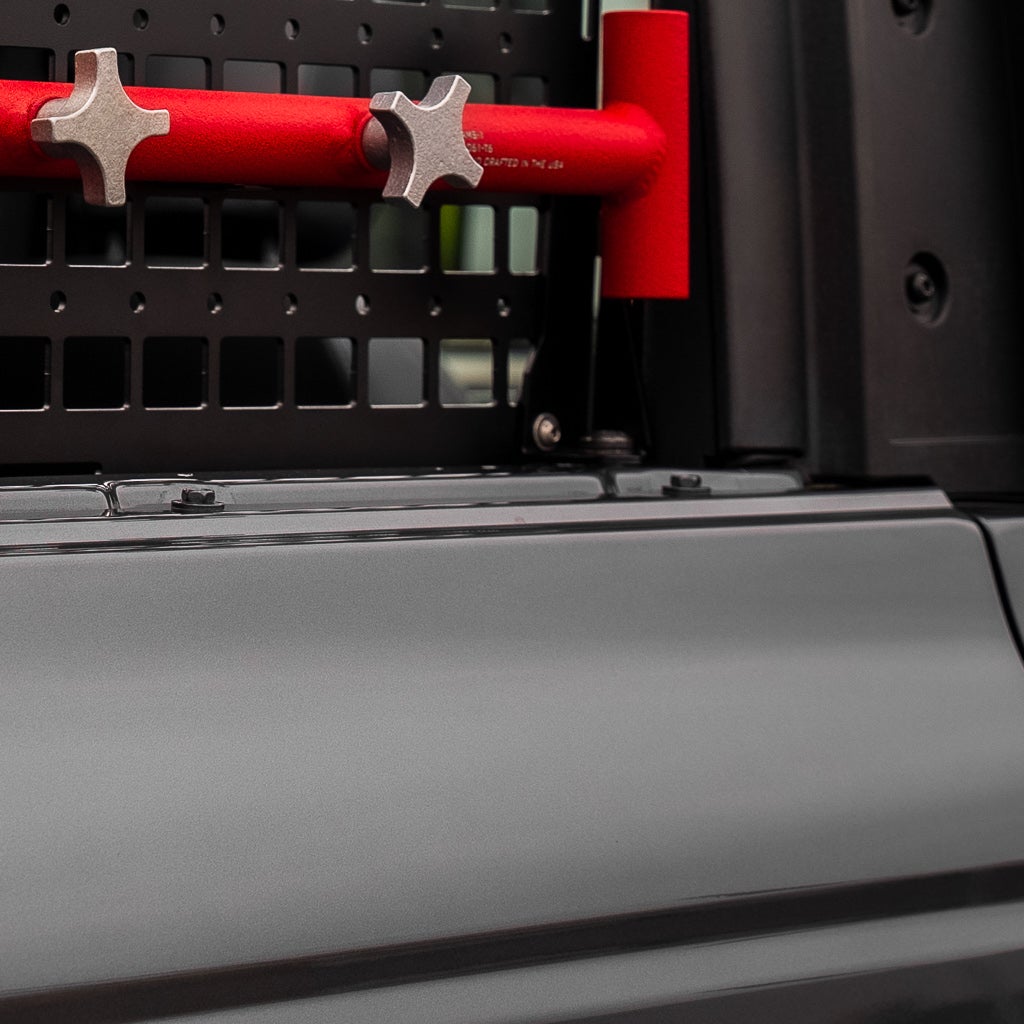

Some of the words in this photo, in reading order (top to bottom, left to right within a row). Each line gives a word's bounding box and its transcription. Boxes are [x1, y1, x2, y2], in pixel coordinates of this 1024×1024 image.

[484, 157, 519, 168] CRAFTED
[532, 159, 546, 169] THE
[548, 160, 564, 169] USA
